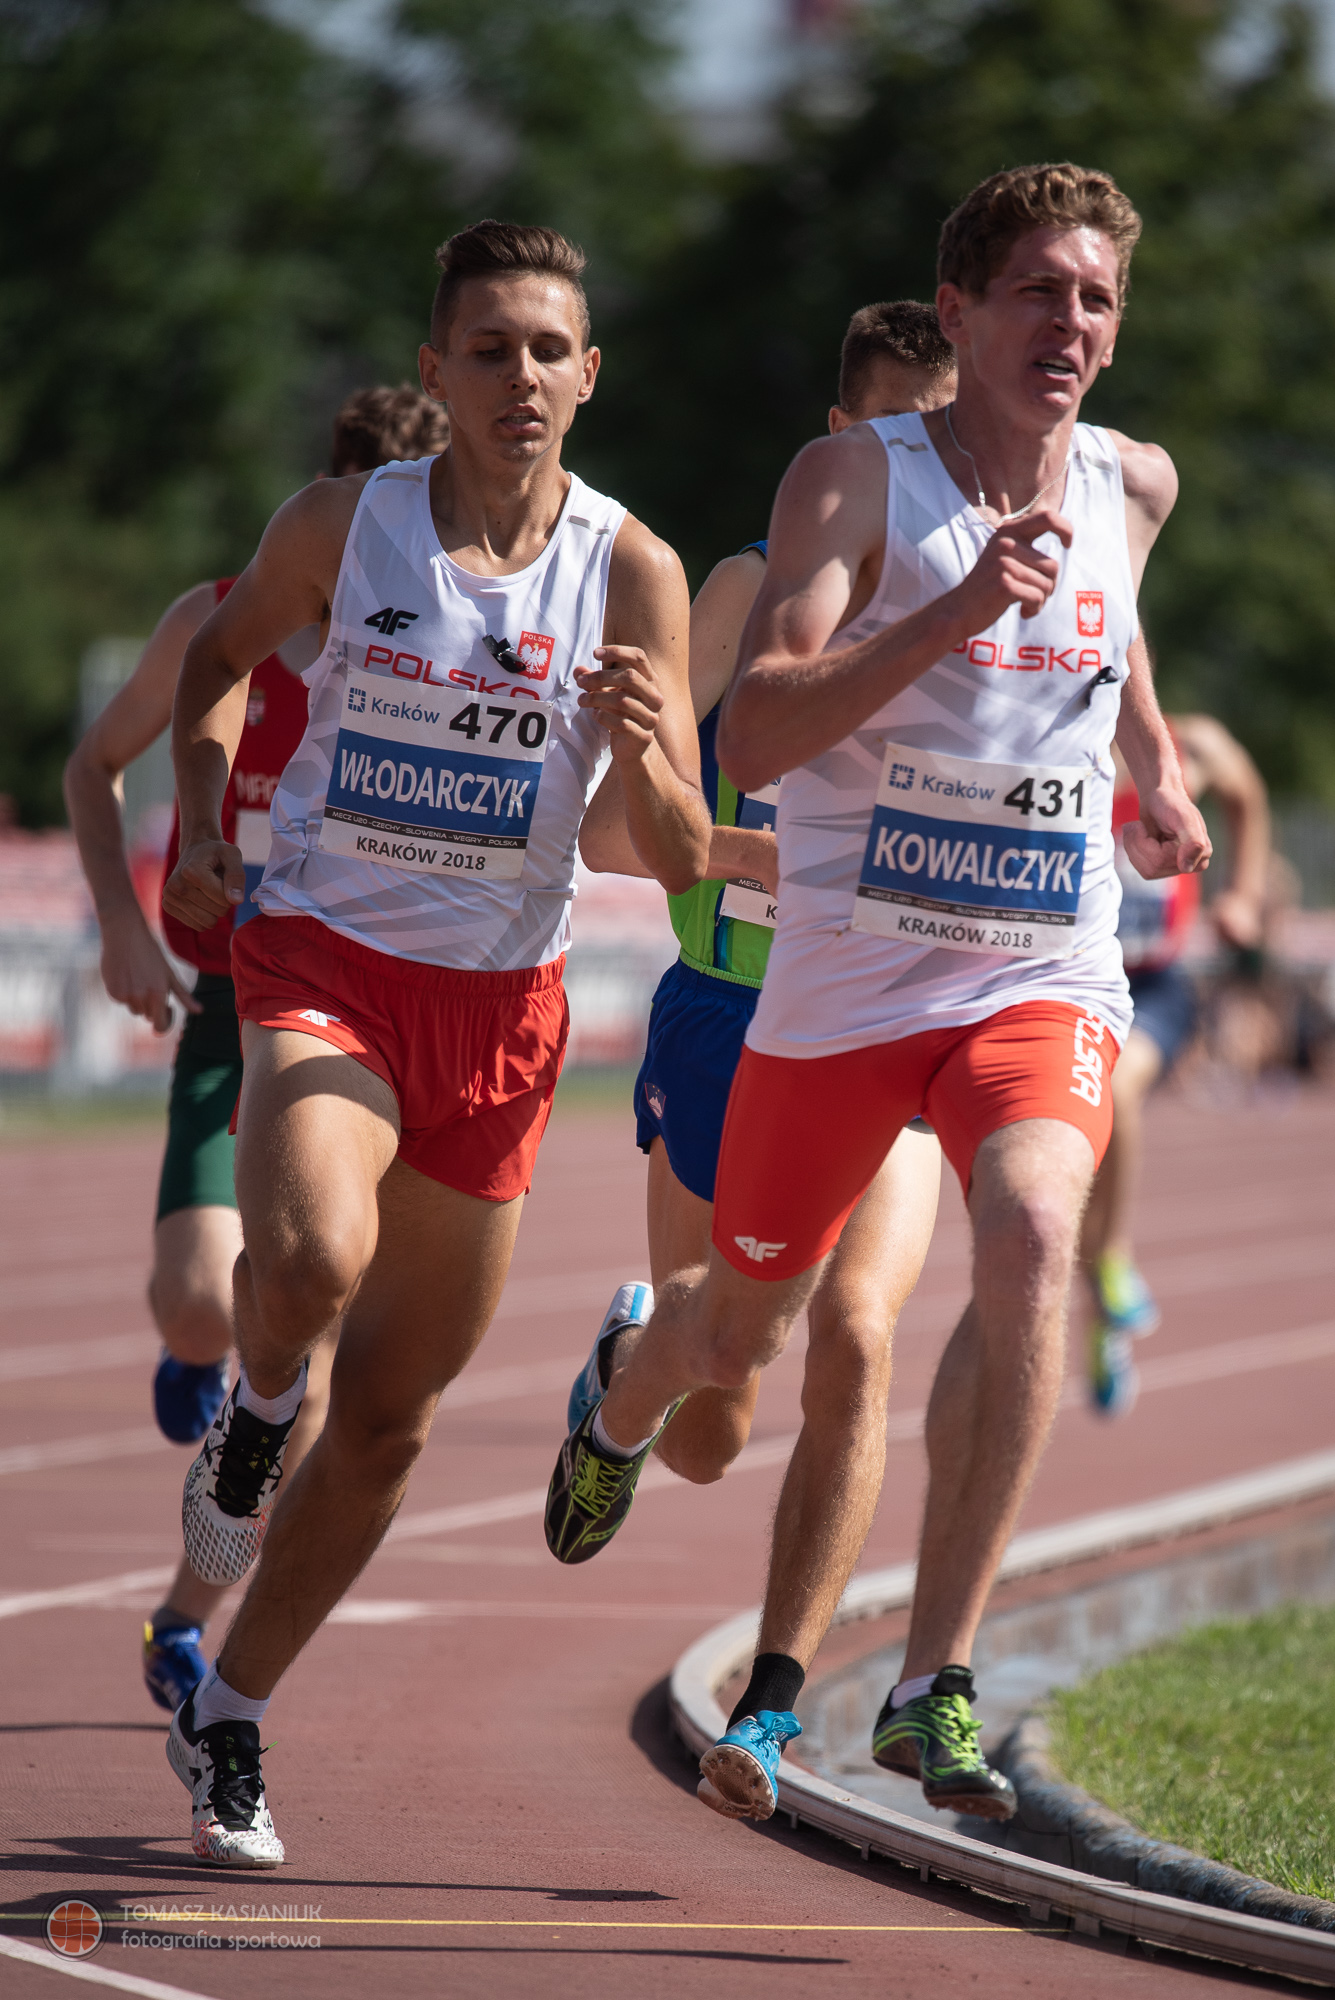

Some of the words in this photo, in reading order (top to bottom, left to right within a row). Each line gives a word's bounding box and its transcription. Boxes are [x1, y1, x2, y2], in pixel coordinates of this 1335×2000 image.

[364, 607, 419, 635] 4F
[523, 633, 552, 645] POLSKA
[371, 697, 440, 724] Kraków
[449, 702, 548, 748] 470
[340, 748, 530, 818] WŁODARCZYK
[922, 775, 995, 801] Kraków
[1004, 777, 1084, 818] 431
[332, 811, 352, 821] MECZ
[353, 815, 368, 825] U20
[488, 839, 518, 848] POLSKA
[356, 836, 437, 864] KRAKÓW
[442, 852, 486, 871] 2018
[873, 826, 1079, 893] KOWALCZYK
[738, 878, 761, 890] MECZ
[867, 890, 892, 900] MECZ
[898, 915, 986, 944] KRAKÓW
[990, 931, 1033, 948] 2018
[734, 1236, 787, 1263] 4F
